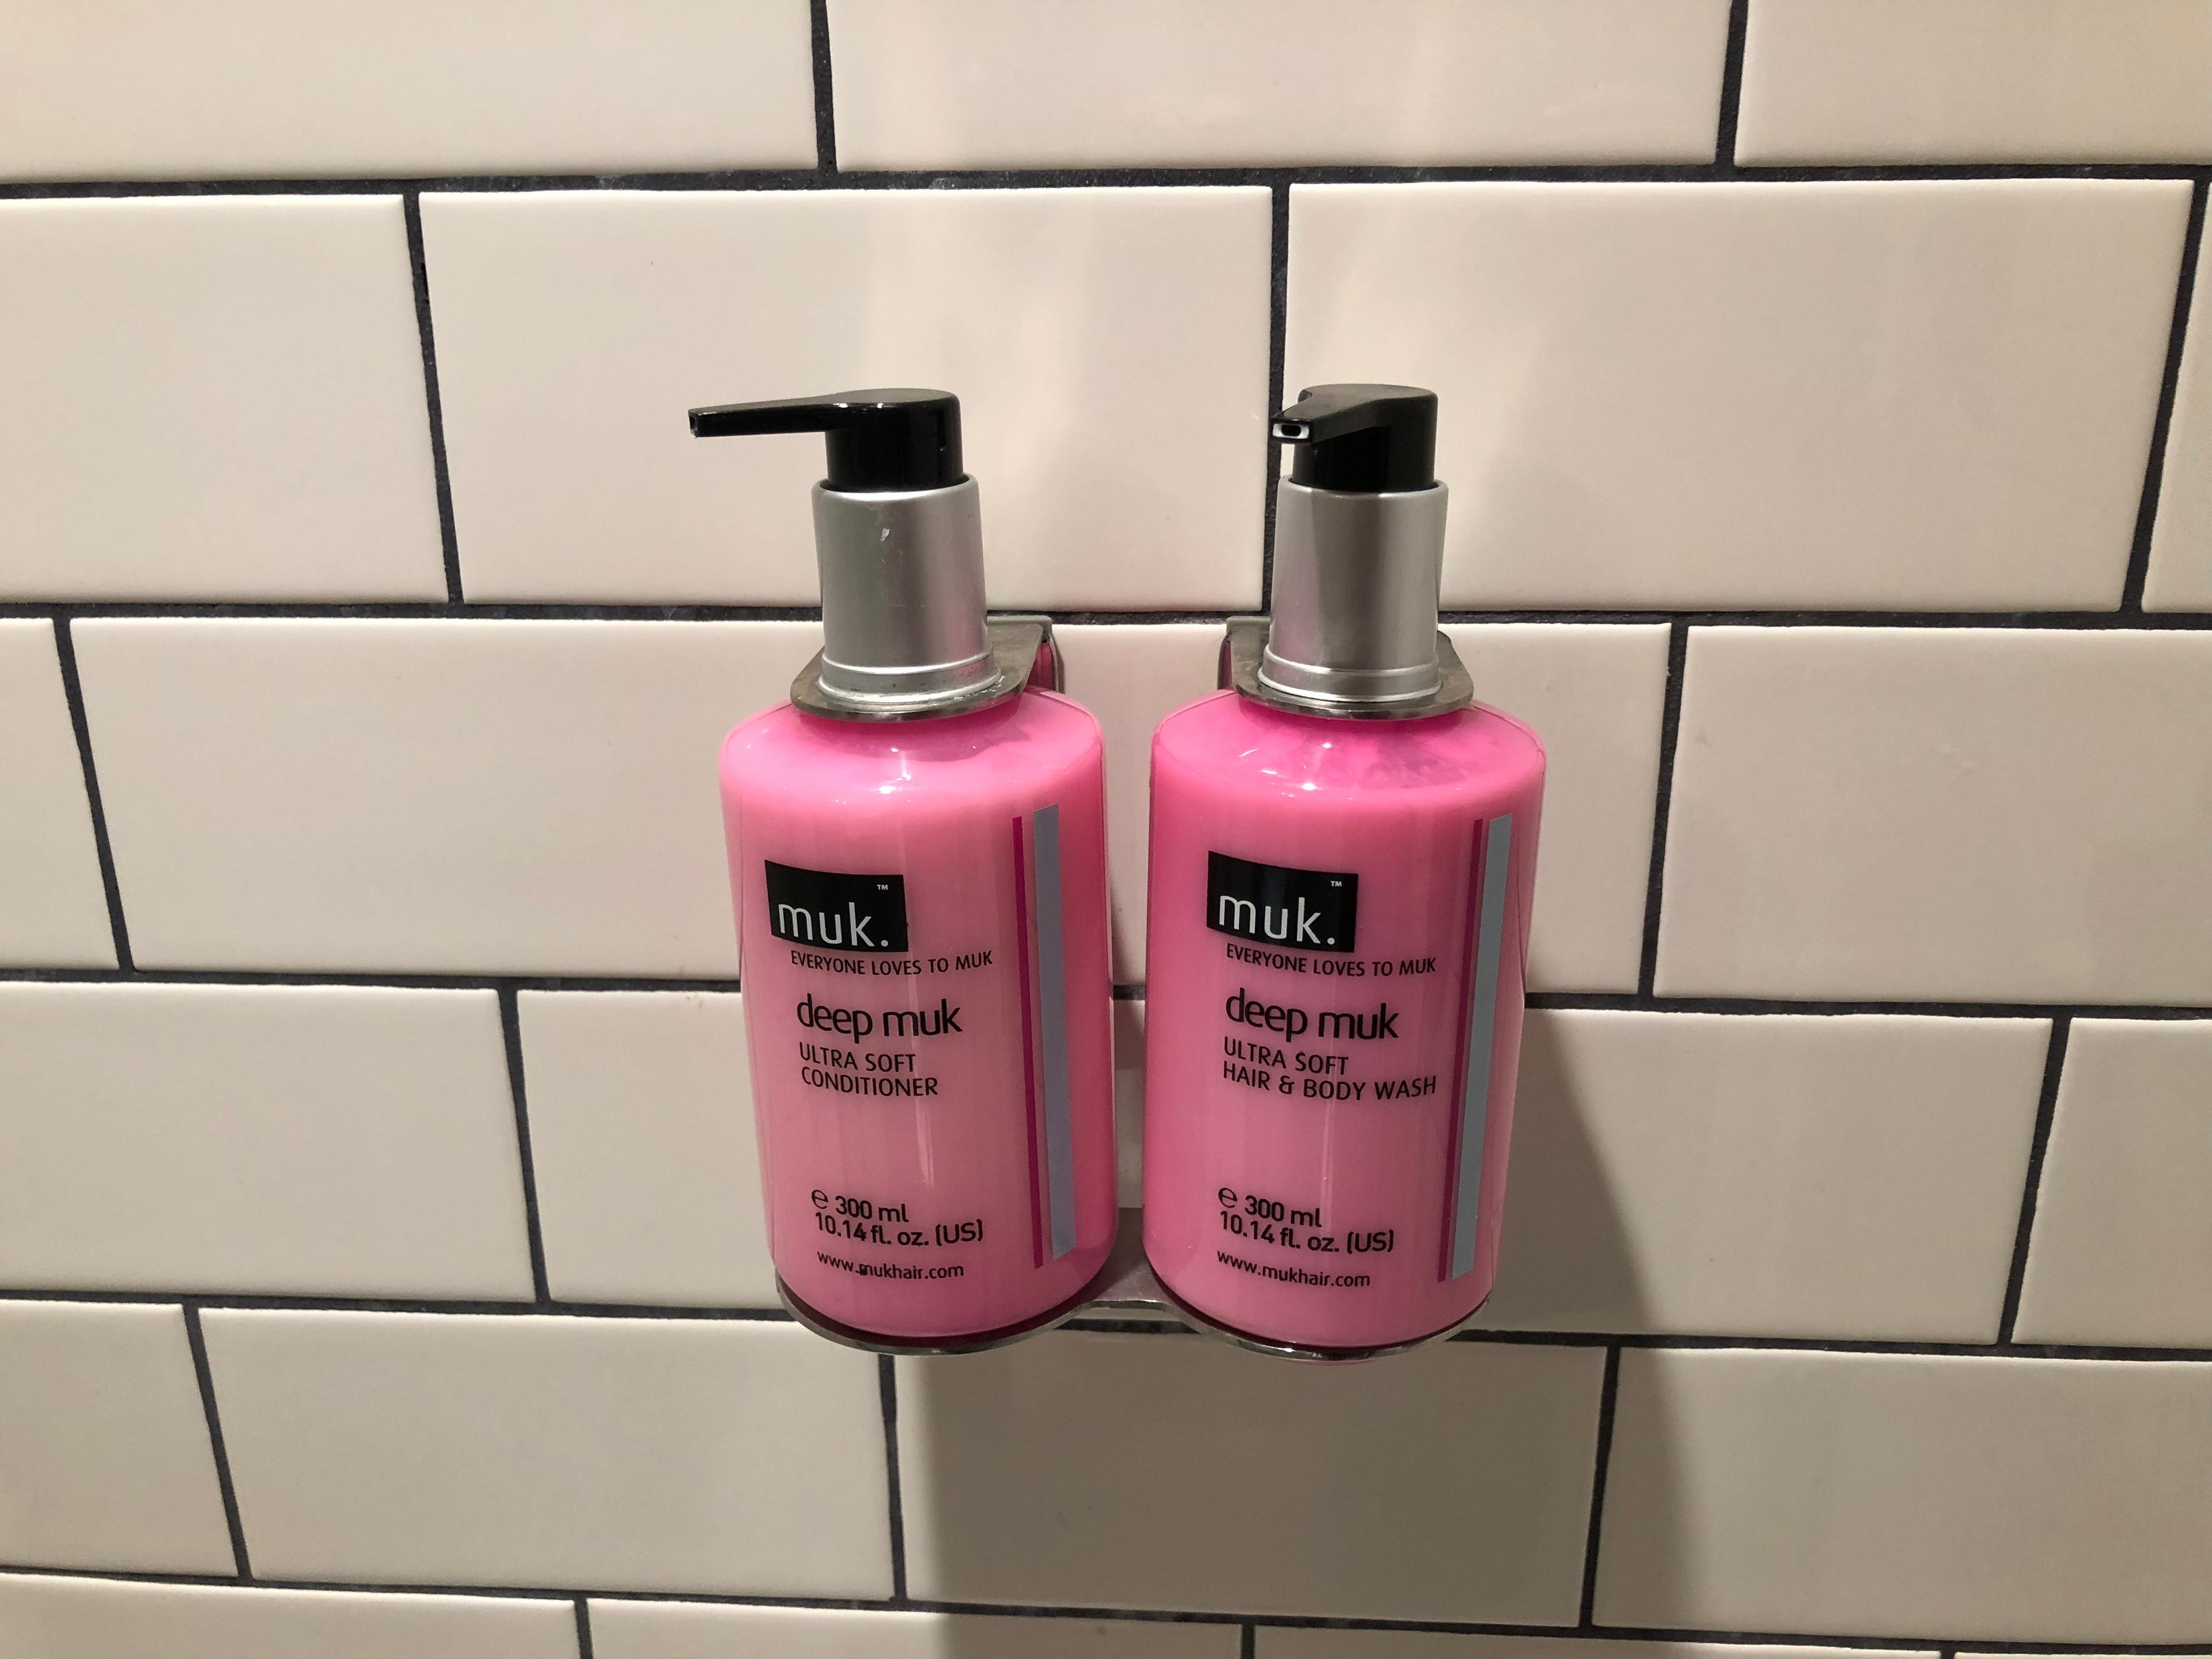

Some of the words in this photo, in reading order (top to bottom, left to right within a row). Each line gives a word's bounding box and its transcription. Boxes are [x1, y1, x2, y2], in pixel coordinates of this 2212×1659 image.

[778, 902, 888, 947] muk.
[1219, 897, 1335, 945] muk.
[791, 950, 866, 975] EVERYONE
[872, 960, 922, 975] LOVES
[927, 958, 948, 973] TO
[955, 950, 993, 971] MUK
[1226, 943, 1306, 972] EVERYONE
[1313, 960, 1365, 977] LOVES
[1372, 961, 1392, 976] TO
[1399, 957, 1437, 975] MUK
[797, 993, 873, 1043] deep
[882, 998, 963, 1036] muk
[1226, 987, 1308, 1042] deep
[1318, 1003, 1399, 1039] muk
[800, 1041, 858, 1070] ULTRA
[865, 1053, 916, 1072] SOFT
[1224, 1036, 1286, 1069] ULTRA
[1295, 1050, 1349, 1075] SOFT
[801, 1066, 938, 1096] CONDITIONER
[1224, 1060, 1270, 1090] HAIR
[1279, 1075, 1294, 1094] &
[1303, 1078, 1366, 1100] BODY
[1374, 1075, 1437, 1100] WASH
[835, 1195, 872, 1219] 300
[878, 1203, 909, 1222] ml
[1244, 1195, 1285, 1222] 300
[1290, 1208, 1322, 1228] ml
[815, 1212, 866, 1241] 10.14
[872, 1225, 892, 1245] fl.
[897, 1231, 929, 1246] oz.
[935, 1219, 983, 1247] (US)
[1220, 1211, 1275, 1244] 10.14
[1280, 1228, 1301, 1248] fl.
[1308, 1236, 1339, 1252] oz.
[1347, 1229, 1394, 1254] (US)
[817, 1252, 964, 1279] www.mukhair.com
[1217, 1251, 1370, 1287] www.mukhair.com
